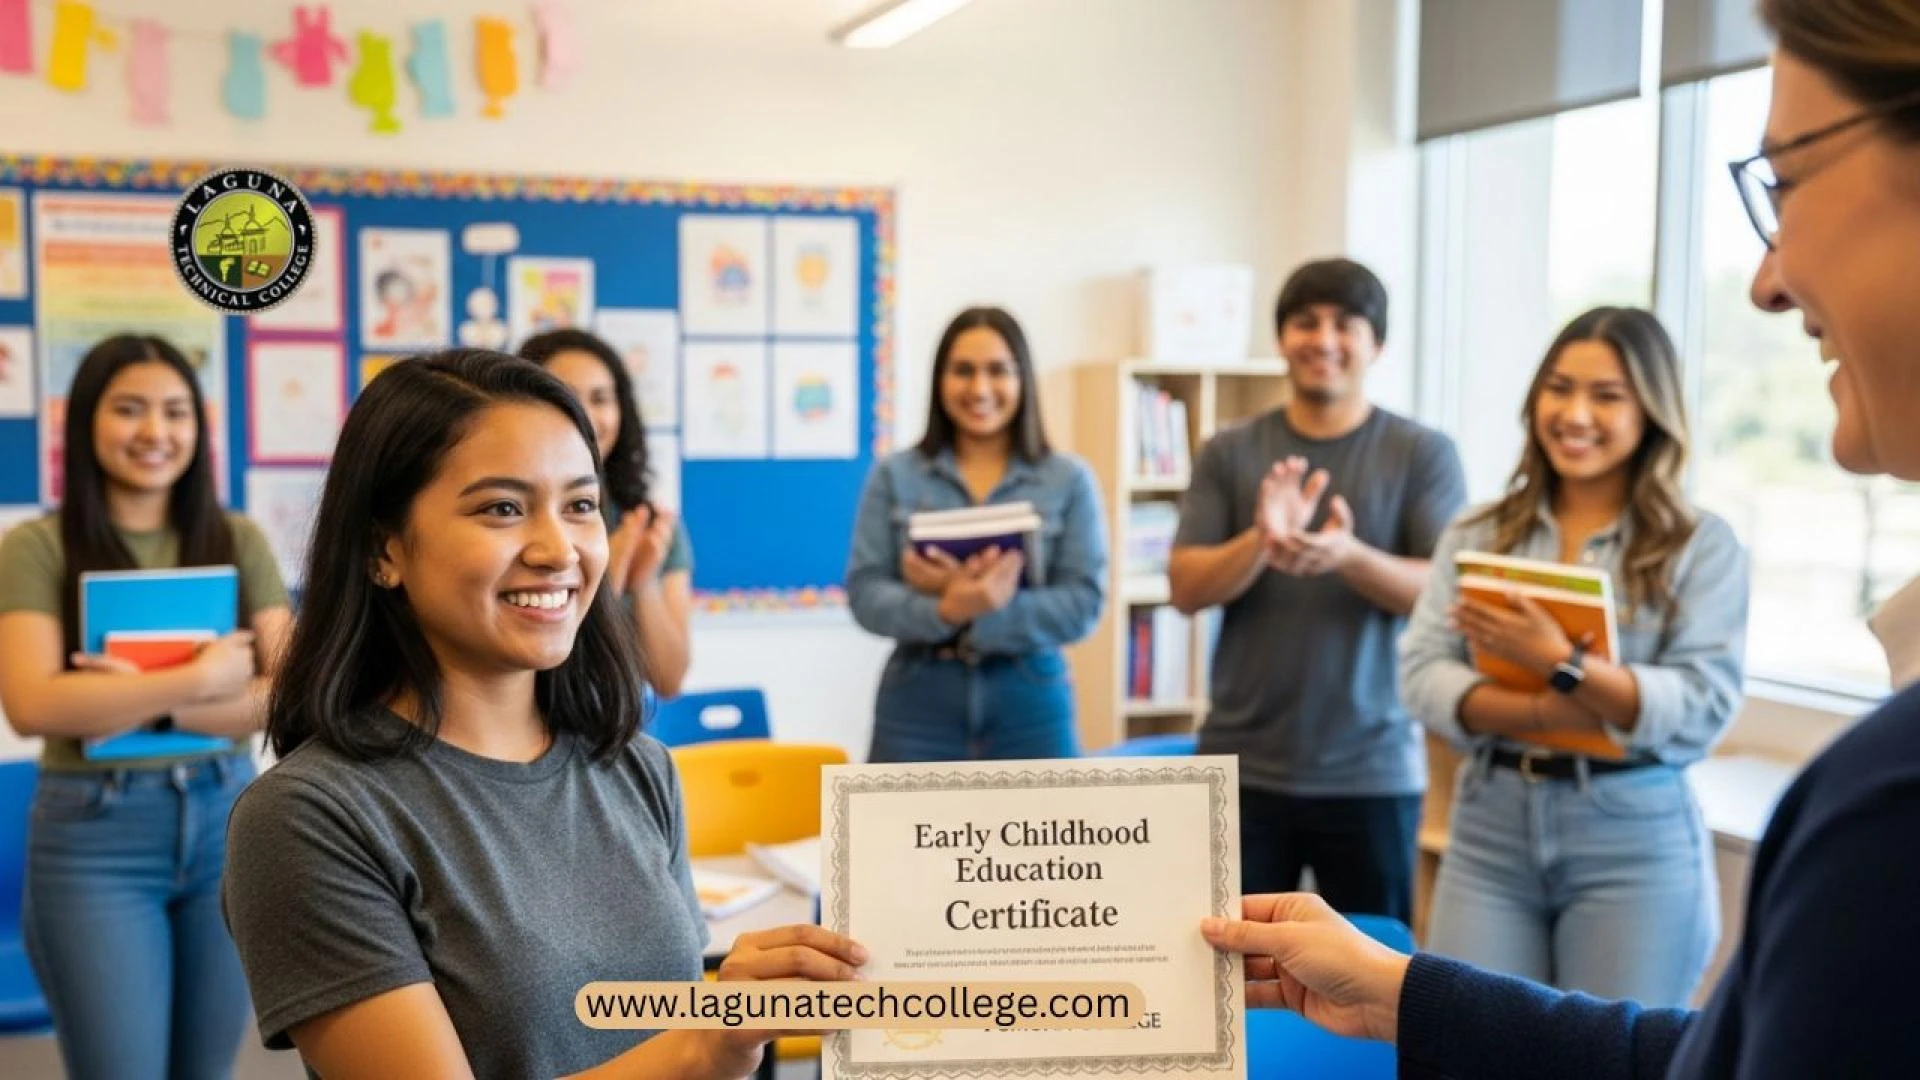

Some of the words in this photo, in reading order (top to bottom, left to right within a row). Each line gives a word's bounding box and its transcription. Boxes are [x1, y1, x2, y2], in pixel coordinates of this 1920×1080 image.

[914, 822, 991, 854] Early
[1000, 818, 1152, 847] Childhood
[955, 855, 1104, 883] Education
[945, 898, 1119, 931] Certificate
